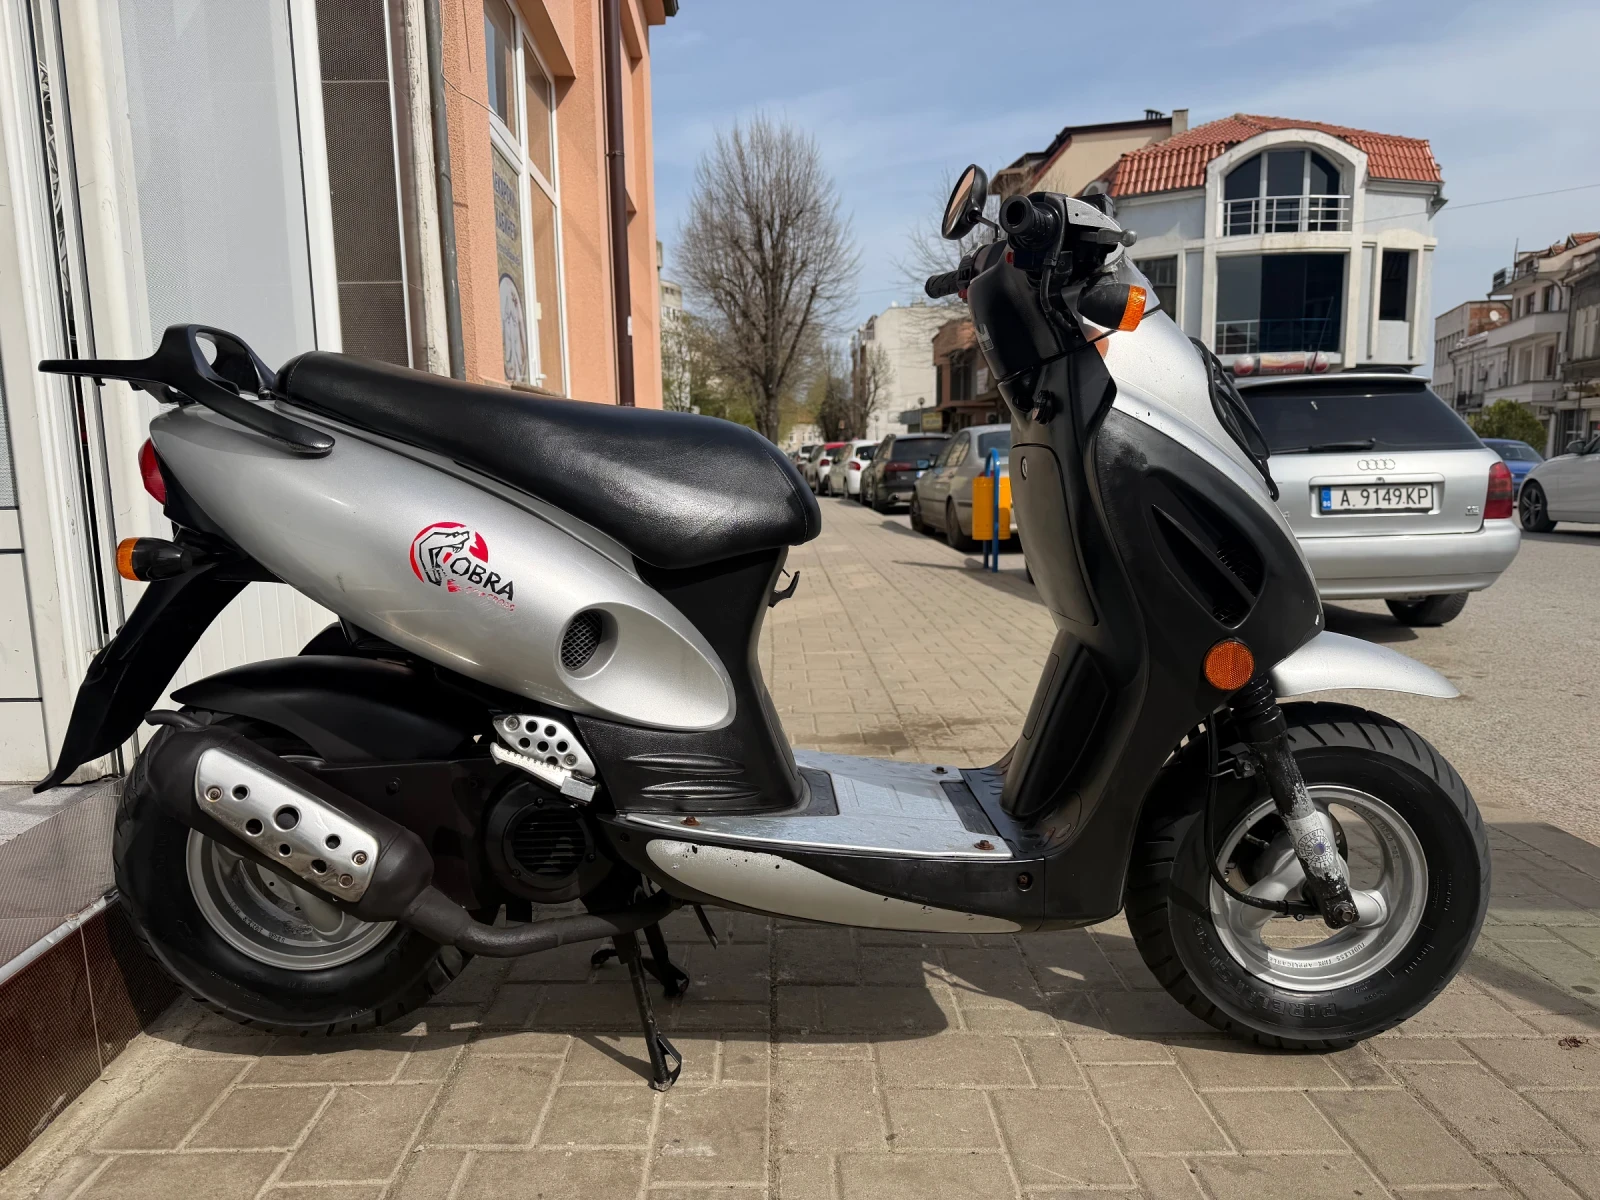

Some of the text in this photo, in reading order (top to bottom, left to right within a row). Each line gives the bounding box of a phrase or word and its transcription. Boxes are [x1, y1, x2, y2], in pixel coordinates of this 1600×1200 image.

[1340, 487, 1428, 506] A 9149 KP
[1230, 979, 1338, 1018] PIRELLI
